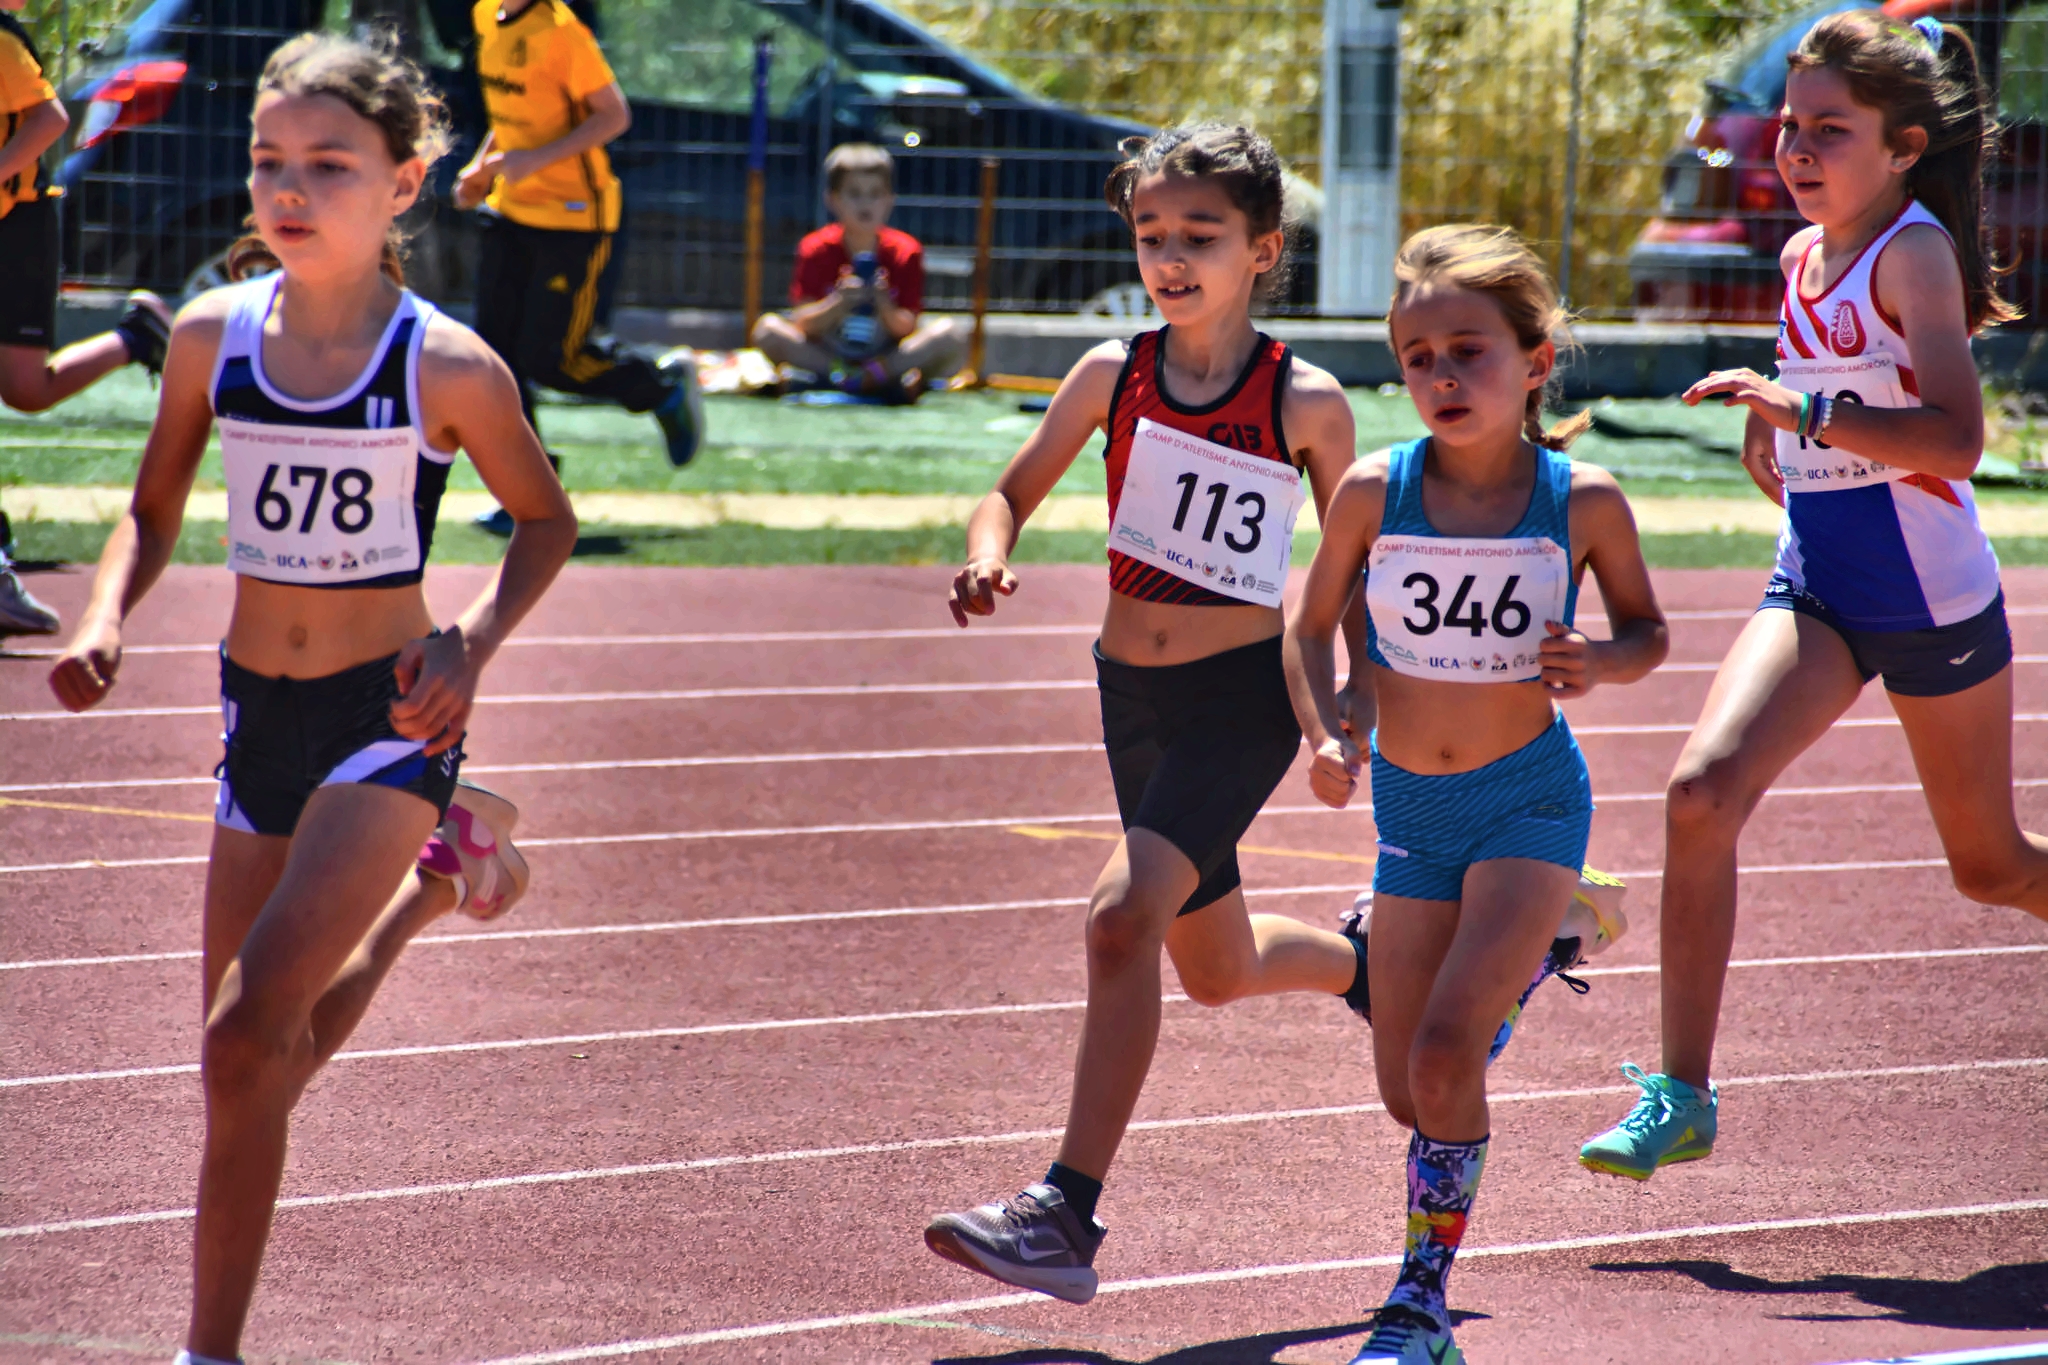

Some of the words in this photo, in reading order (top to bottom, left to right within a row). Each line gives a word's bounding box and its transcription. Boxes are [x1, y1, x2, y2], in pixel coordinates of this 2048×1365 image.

[1145, 429, 1174, 446] CAMP
[1174, 438, 1228, 464] D'ATLETISME
[1229, 459, 1272, 477] ANTONIO
[1807, 463, 1829, 480] UCA
[255, 464, 373, 535] 678
[1172, 472, 1265, 554] 113
[276, 554, 308, 569] UCA
[1166, 548, 1194, 570] UCA
[1377, 543, 1405, 553] CAMP
[1405, 543, 1463, 557] D'ATLETISME
[1464, 546, 1514, 558] ANTONIO
[1402, 572, 1531, 638] 346
[1429, 656, 1460, 669] UCA
